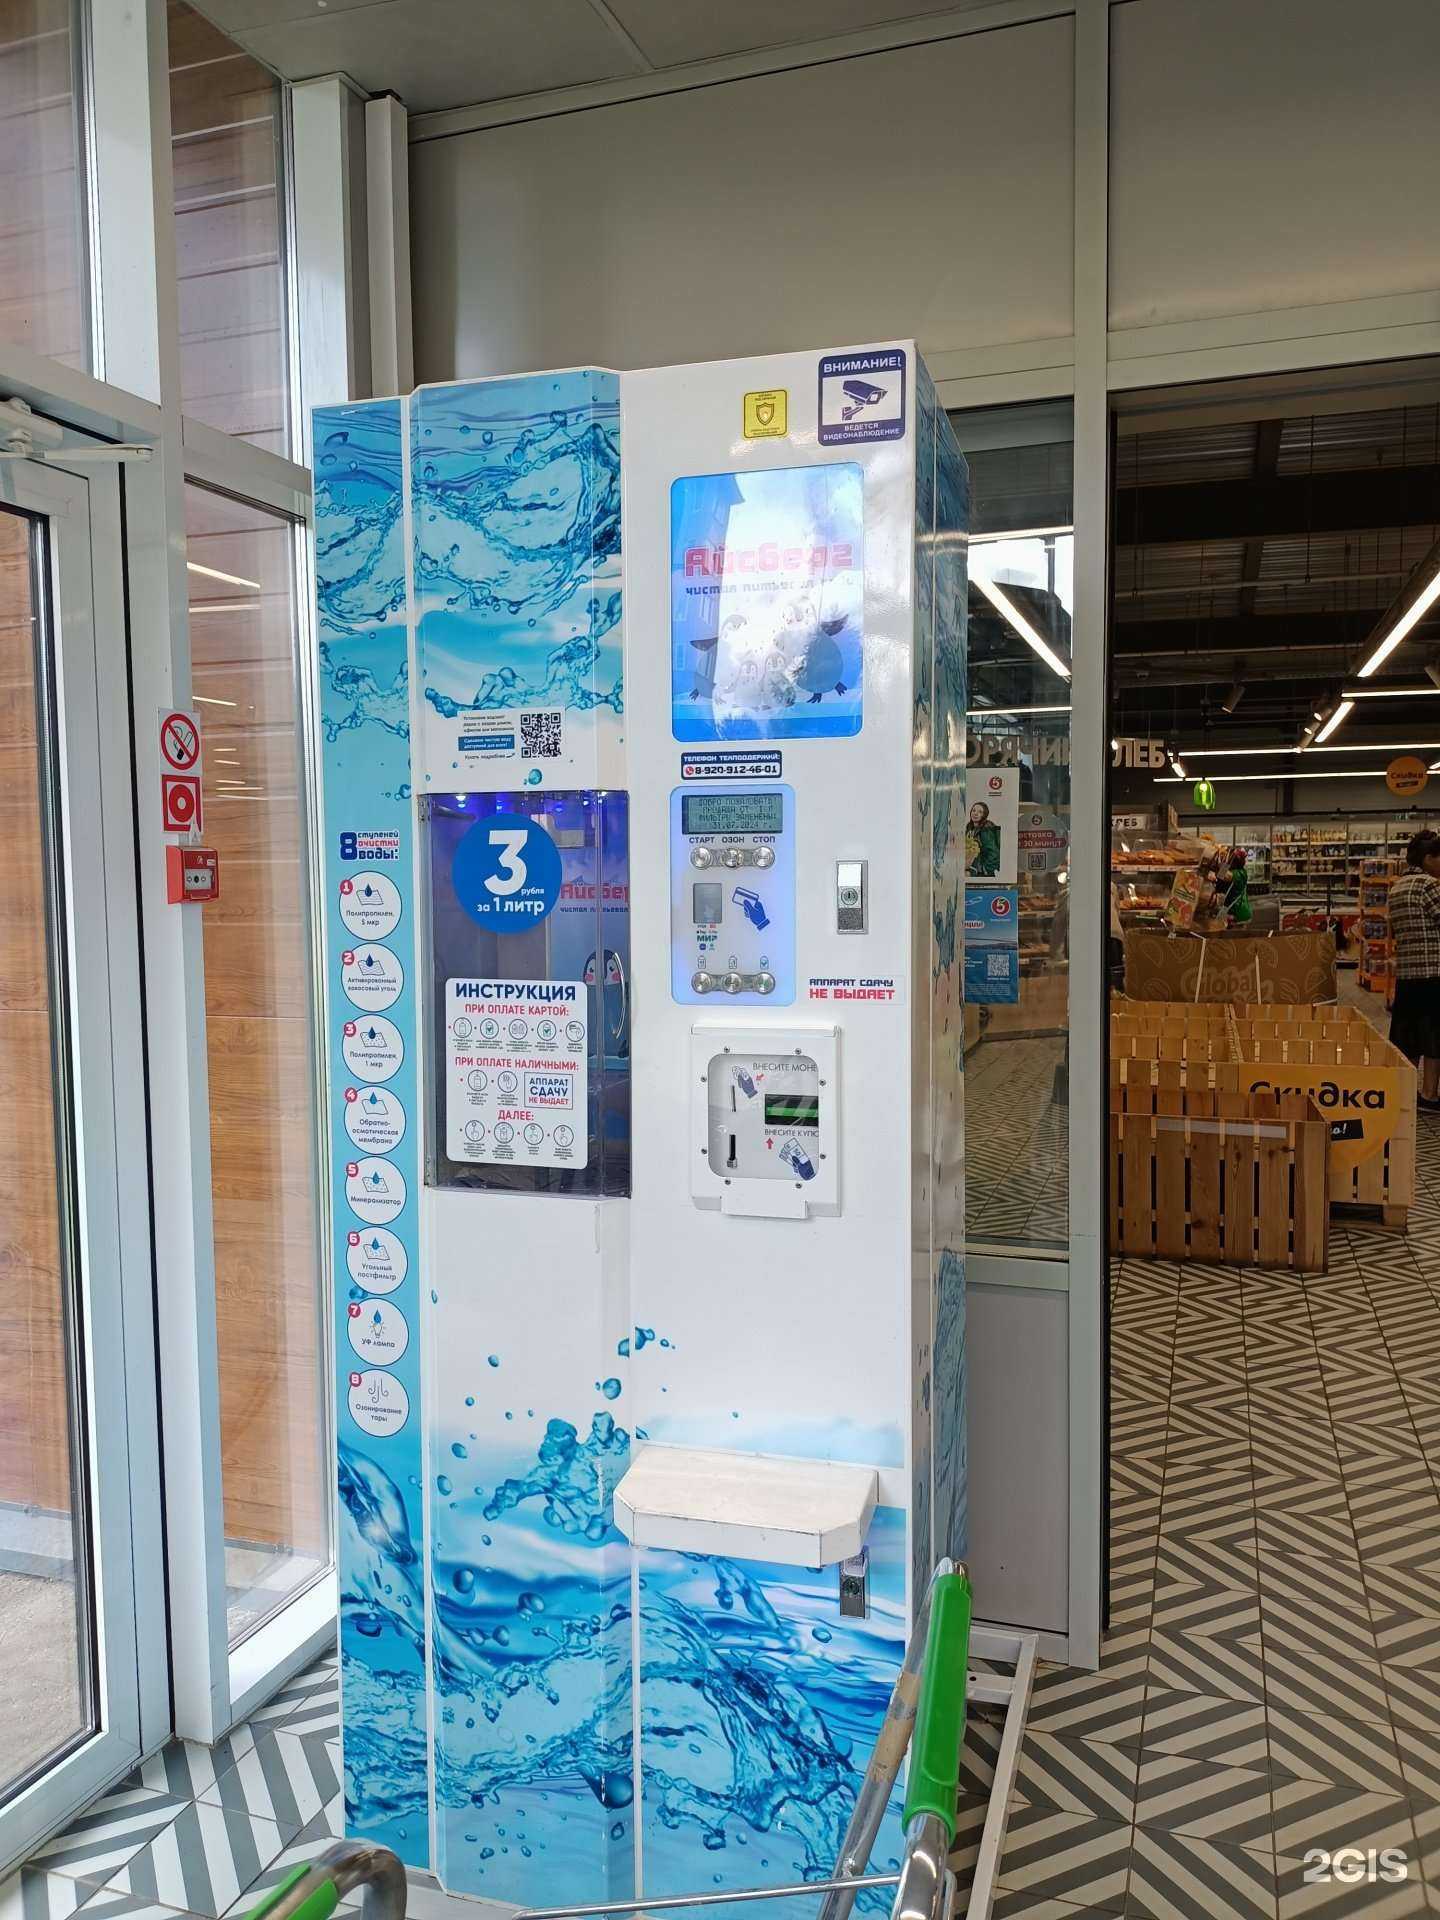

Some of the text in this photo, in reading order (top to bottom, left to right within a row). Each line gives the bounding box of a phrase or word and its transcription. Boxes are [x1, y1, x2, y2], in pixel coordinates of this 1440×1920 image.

[823, 356, 902, 373] ВНИМАНИЕ!
[844, 423, 879, 431] ВЕДЕТСЯ
[823, 428, 900, 441] ВИДЕОНАБЛЮДЕНИЕ
[1112, 738, 1165, 768] ЛЕБ
[695, 765, 777, 774] 8-920-912-46-01
[689, 836, 715, 844] СТАРТ
[752, 835, 776, 843] СТОП
[340, 831, 399, 860] 8 ступеней
[359, 848, 398, 859] воды:
[484, 830, 545, 896] 3 рубля
[477, 897, 545, 915] за 1 литр
[809, 978, 894, 987] АППАРАТ СДАЧУ
[455, 983, 576, 1002] ИНСТРУКЦИЯ
[809, 989, 895, 1000] НЕ ВЫДАЕТ
[465, 1004, 569, 1016] ПРИ ОПЛАТЕ КАРТОЙ:
[455, 1057, 579, 1070] ПРИ ОПЛАТЕ НАЛИЧНЫМИ:
[753, 1063, 818, 1072] ВНЕСИТЕ МОНЕ
[529, 1077, 569, 1086] АППАРАТ
[530, 1086, 568, 1097] СДАЧУ
[540, 1097, 569, 1105] ВЫДАЕТ
[498, 1109, 534, 1121] ДАЛЕЕ:
[765, 1129, 796, 1137] ВНЕСИТЕ
